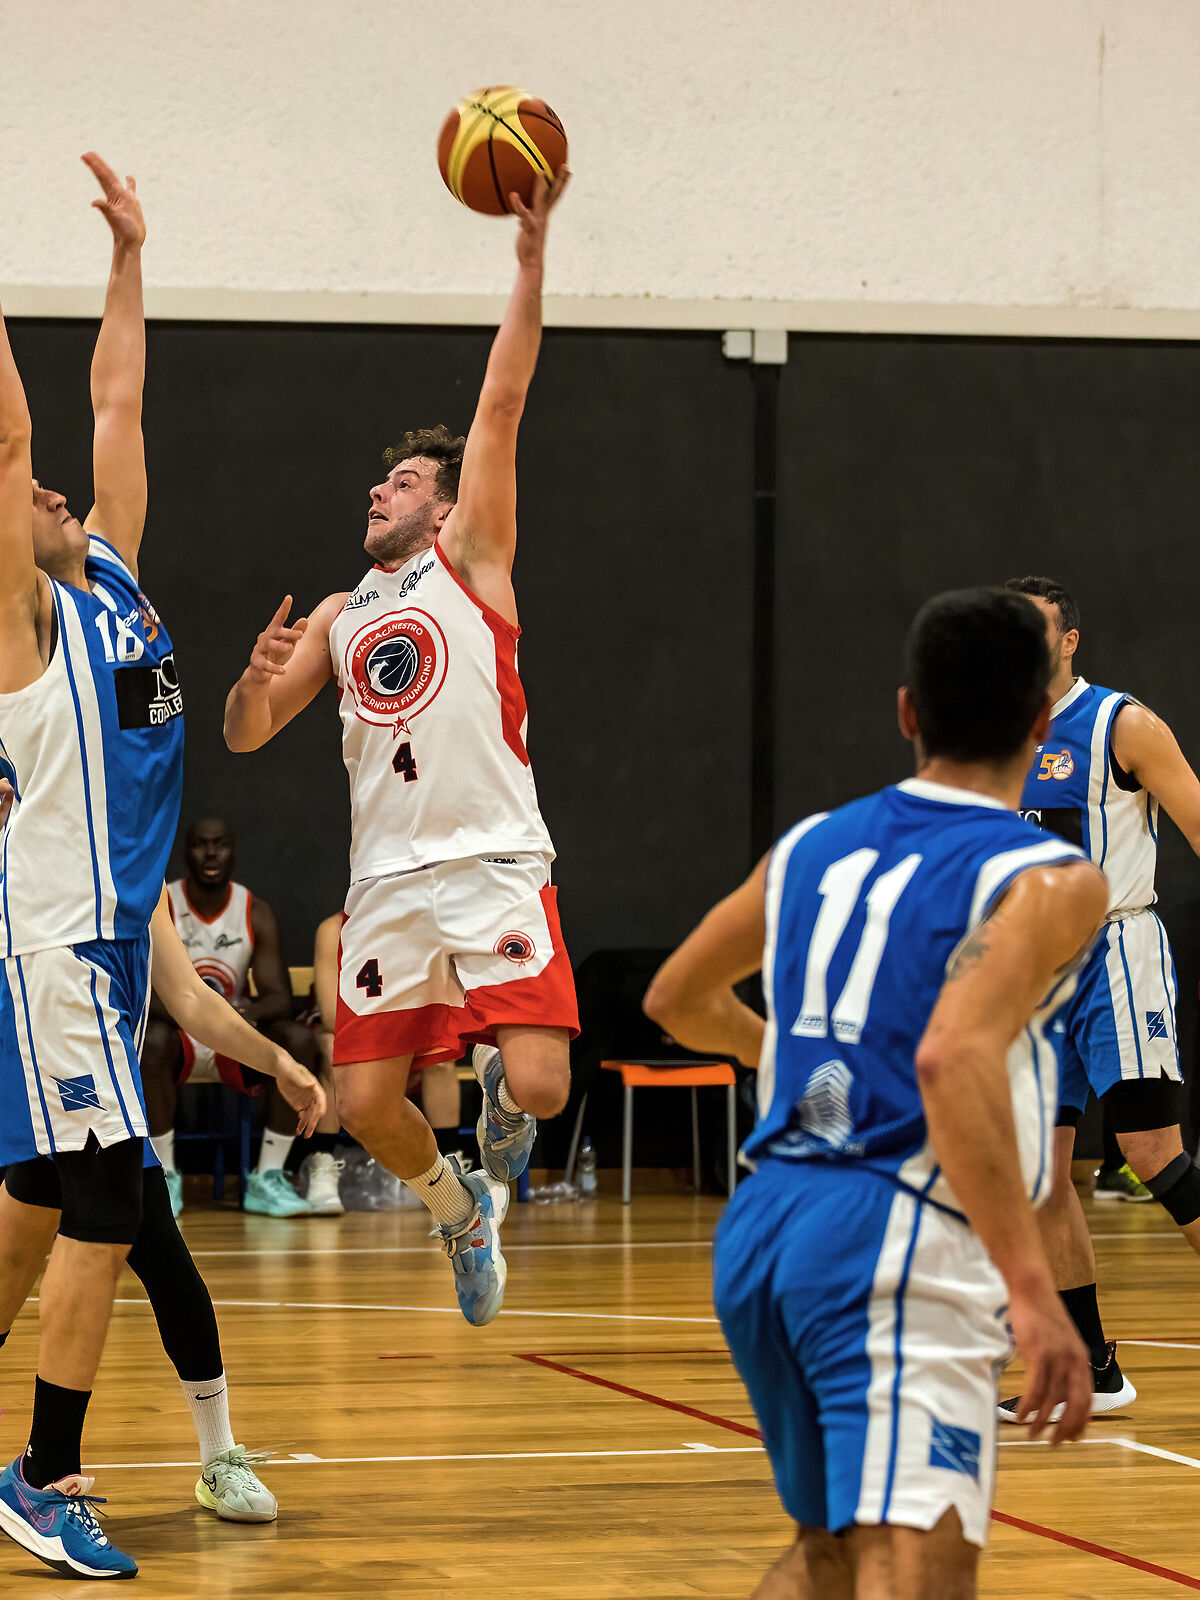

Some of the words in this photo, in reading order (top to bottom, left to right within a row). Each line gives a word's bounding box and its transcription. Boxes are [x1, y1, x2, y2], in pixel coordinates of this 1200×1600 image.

[355, 622, 424, 659] PALLACANESTRO
[358, 681, 400, 710] SUERNOVA
[400, 655, 433, 706] FIUMICINO
[392, 741, 419, 783] 4
[790, 847, 923, 1045] 11
[356, 958, 383, 998] 4
